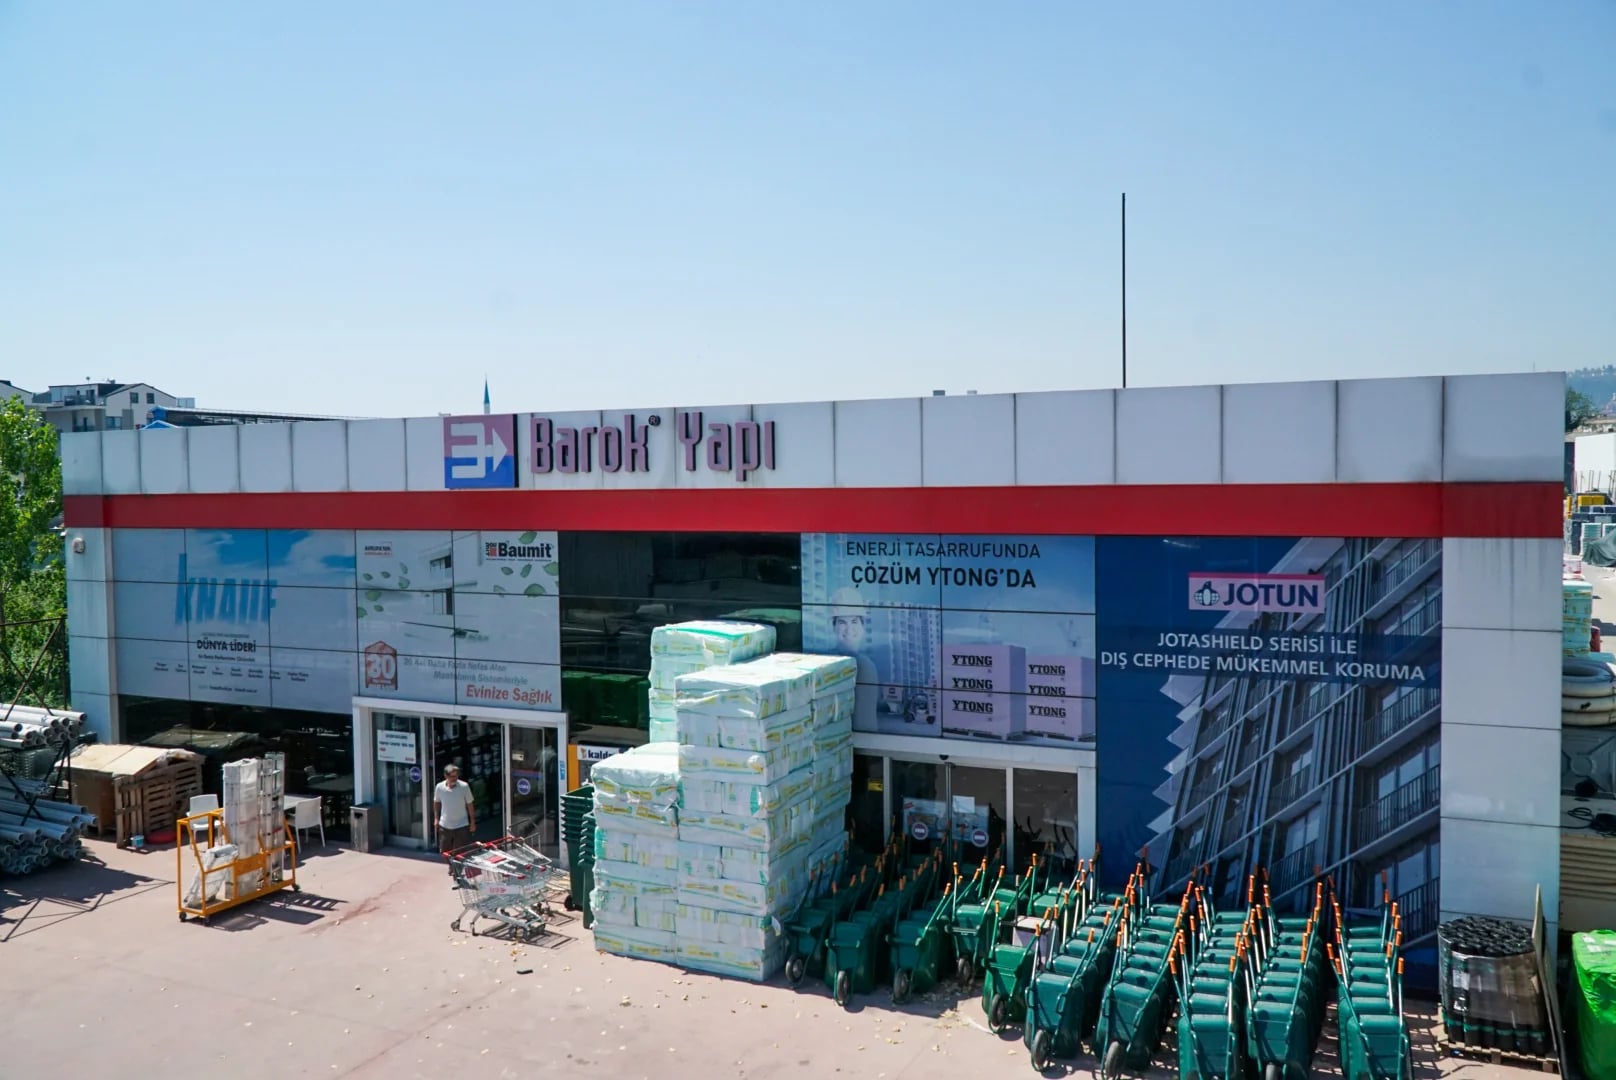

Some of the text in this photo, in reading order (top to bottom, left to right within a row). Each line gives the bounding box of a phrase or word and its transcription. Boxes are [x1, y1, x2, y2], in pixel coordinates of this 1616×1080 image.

[531, 412, 777, 482] Barok Yapı
[498, 542, 552, 558] Baumit
[847, 538, 1040, 559] ENERJİ TASARRUFUNDA
[851, 562, 1037, 589] ÇÖZÜM YTONG'DA
[1223, 582, 1319, 608] JOTUN
[197, 637, 257, 653] DÜNYA LİDERİ
[1157, 632, 1358, 655] JOTASHIELD SERİSİ İLE
[367, 653, 396, 680] 30
[952, 654, 993, 666] YTONG
[1101, 651, 1426, 682] DIŞ CEPHEDE MÜKEMMEL KORUMA
[1028, 664, 1066, 675] YTONG
[952, 677, 993, 689] YTONG
[1029, 685, 1066, 696] YTONG
[466, 683, 553, 705] Evinize Sağlık
[952, 700, 993, 713] YTONG
[1029, 705, 1066, 718] YTONG
